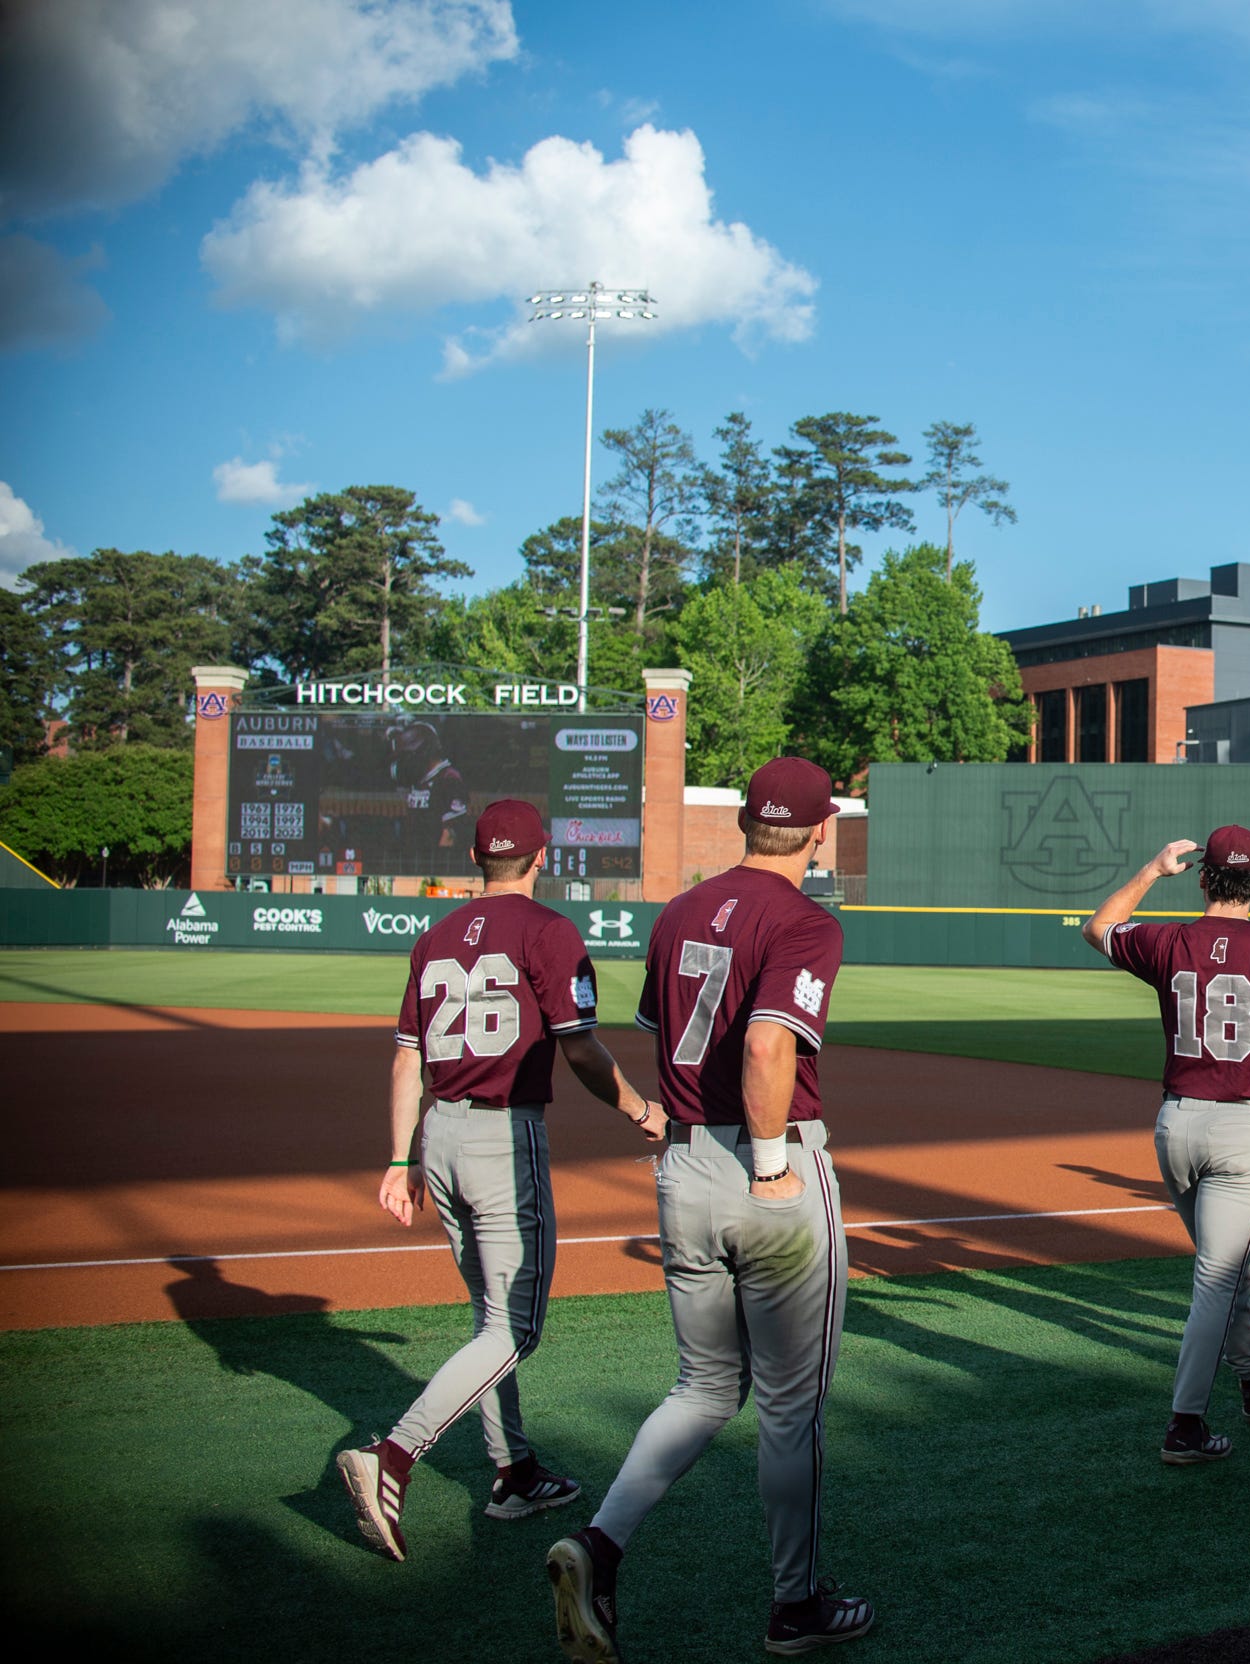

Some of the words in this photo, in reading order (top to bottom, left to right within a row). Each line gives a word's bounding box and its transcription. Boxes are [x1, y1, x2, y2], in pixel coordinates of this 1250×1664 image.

[297, 684, 466, 704] HITCHCOCK
[495, 685, 579, 705] FIELD
[237, 717, 317, 731] AUBURN
[240, 737, 311, 748] BASEBALL
[566, 735, 588, 746] WAYS
[590, 735, 600, 746] TO
[601, 735, 627, 746] LISTEN
[242, 803, 270, 814] 1967
[760, 800, 791, 818] State
[242, 816, 270, 827] 1994
[275, 816, 303, 827] 1997
[242, 828, 270, 838] 2019
[275, 828, 303, 838] 2022
[488, 837, 514, 852] State
[602, 857, 632, 869] 5:42
[254, 908, 322, 924] COOK'S
[167, 918, 218, 932] Alabama
[254, 923, 277, 931] PEST
[278, 924, 321, 932] CONTROL
[175, 932, 210, 944] Power
[420, 952, 520, 1063] 26
[672, 940, 733, 1065] 7
